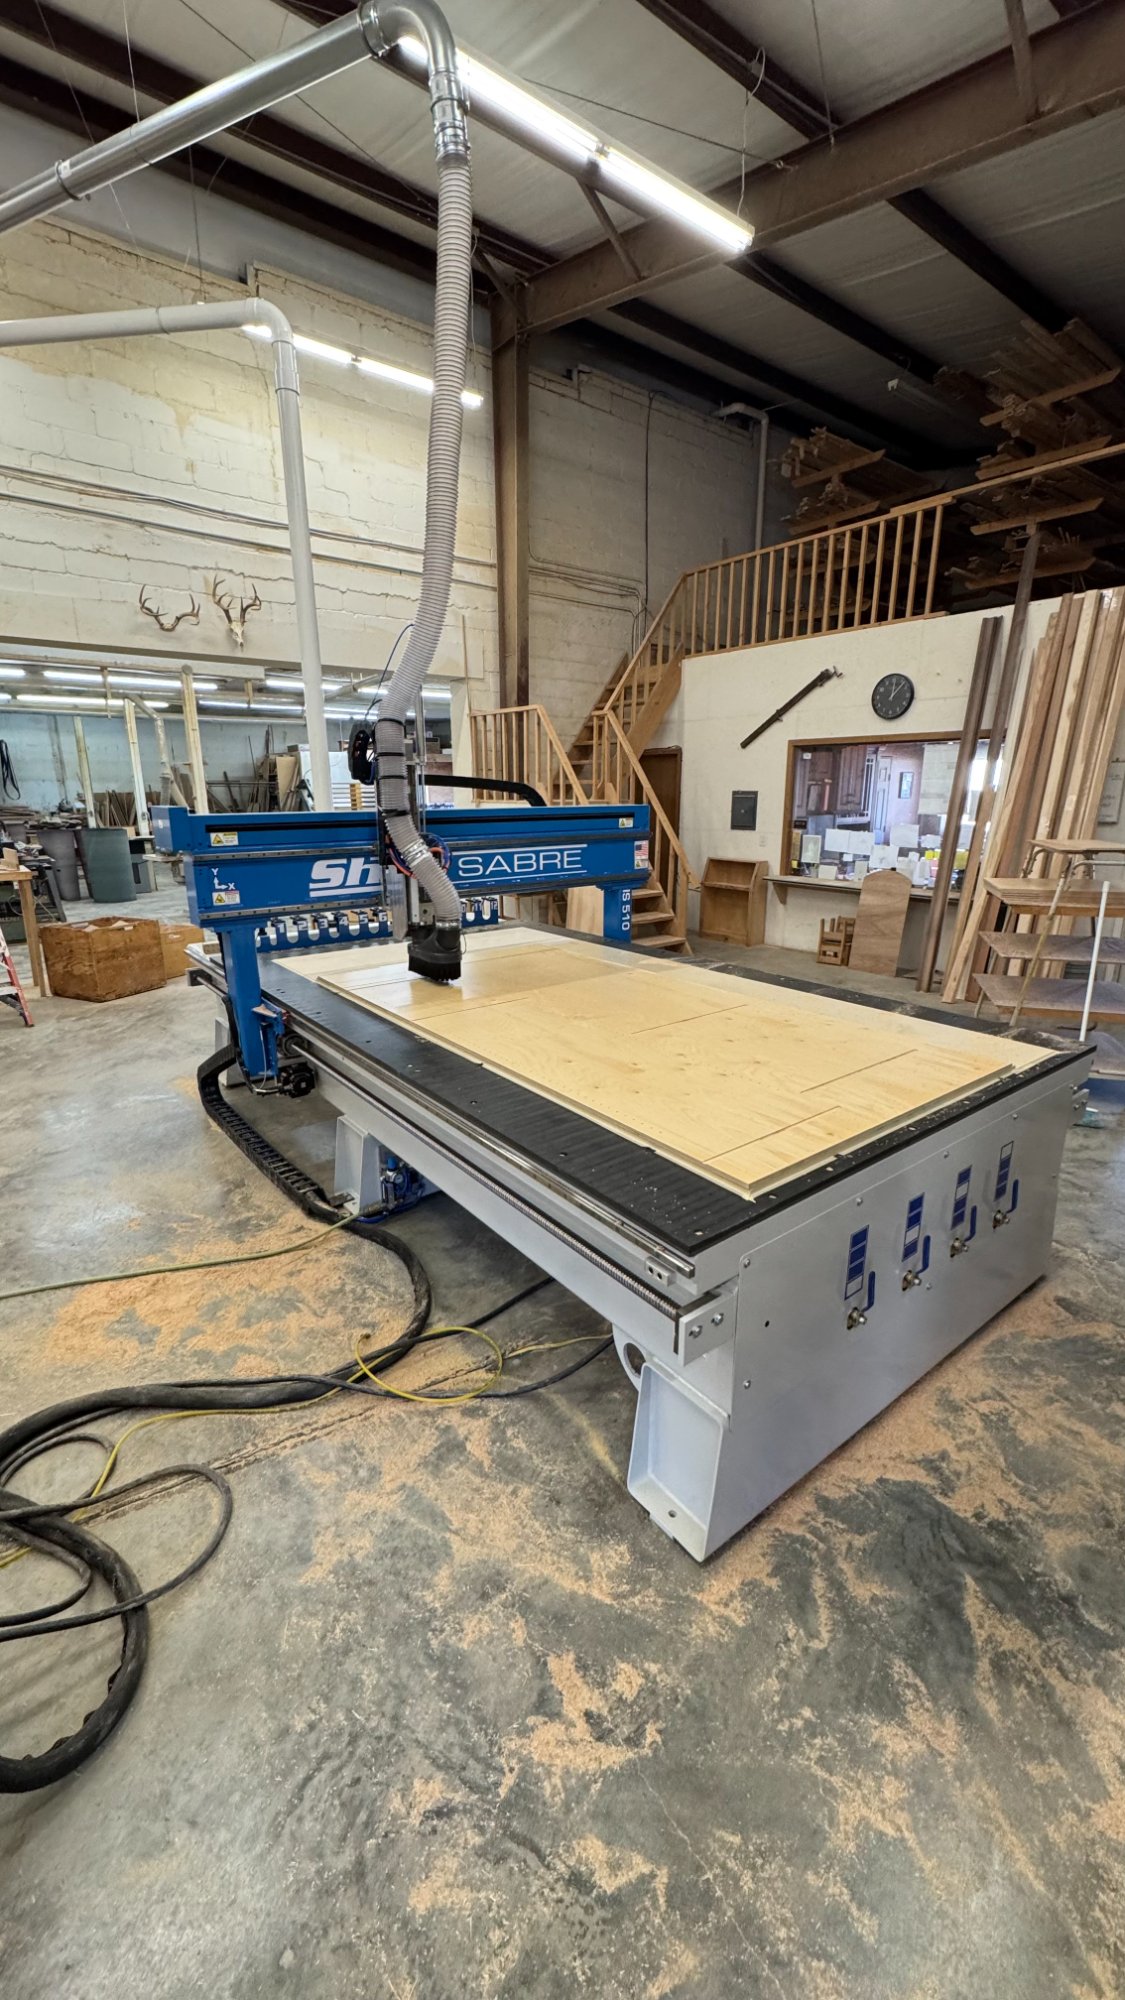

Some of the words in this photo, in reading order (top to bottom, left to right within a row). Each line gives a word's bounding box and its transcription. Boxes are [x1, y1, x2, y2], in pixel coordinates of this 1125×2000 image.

[211, 867, 219, 876] Y
[309, 857, 380, 890] Sh
[458, 849, 582, 877] SABRE
[228, 882, 236, 890] X
[622, 889, 631, 902] IS
[491, 901, 498, 910] 12
[277, 922, 285, 933] 1
[298, 921, 308, 930] 2
[319, 918, 328, 928] 3
[339, 916, 348, 926] 4
[360, 913, 368, 924] 5
[379, 912, 387, 922] 6
[621, 904, 631, 931] 510
